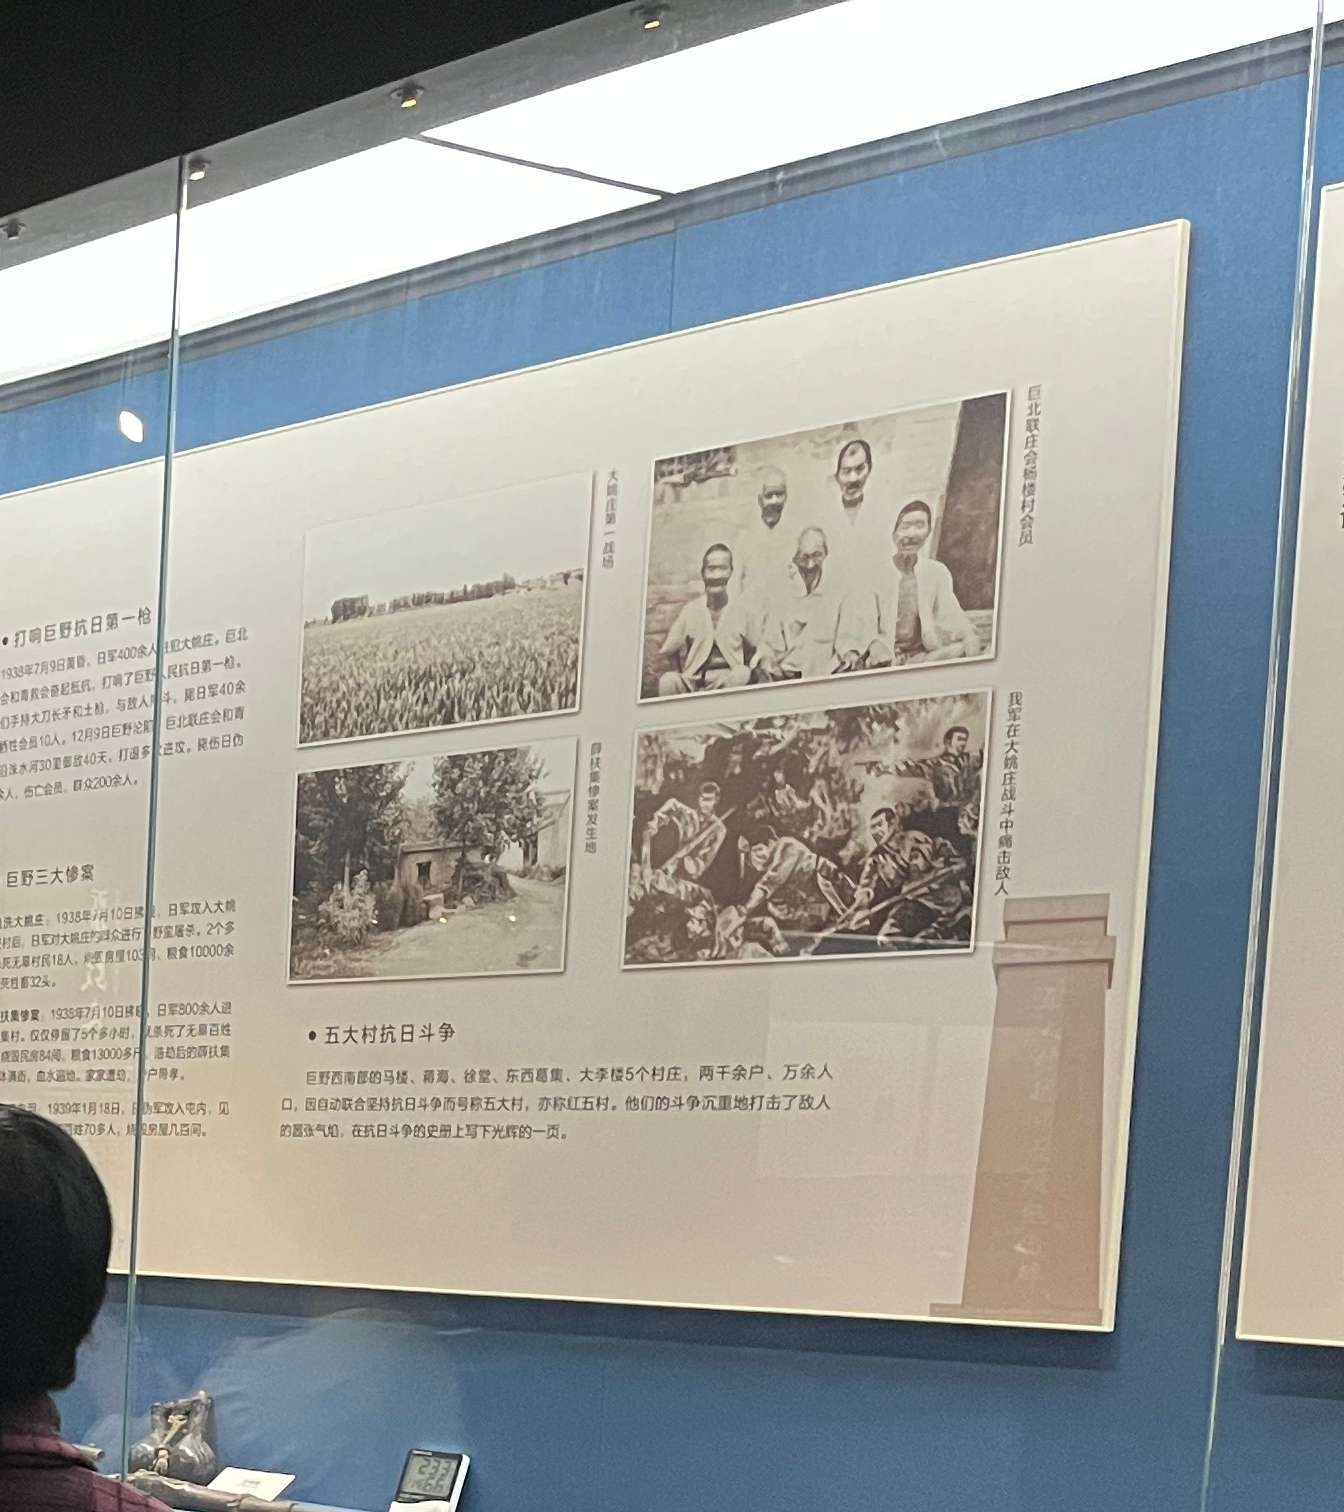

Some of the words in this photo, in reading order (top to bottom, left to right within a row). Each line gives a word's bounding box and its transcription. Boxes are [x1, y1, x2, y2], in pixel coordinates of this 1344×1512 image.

[13, 606, 153, 649] 打响巨野抗日第一枪
[994, 691, 1024, 896] 我军在大姚庄战斗中痛击敌人
[6, 864, 95, 889] 巨野三大惨案
[324, 1022, 457, 1048] 五大村抗日斗争
